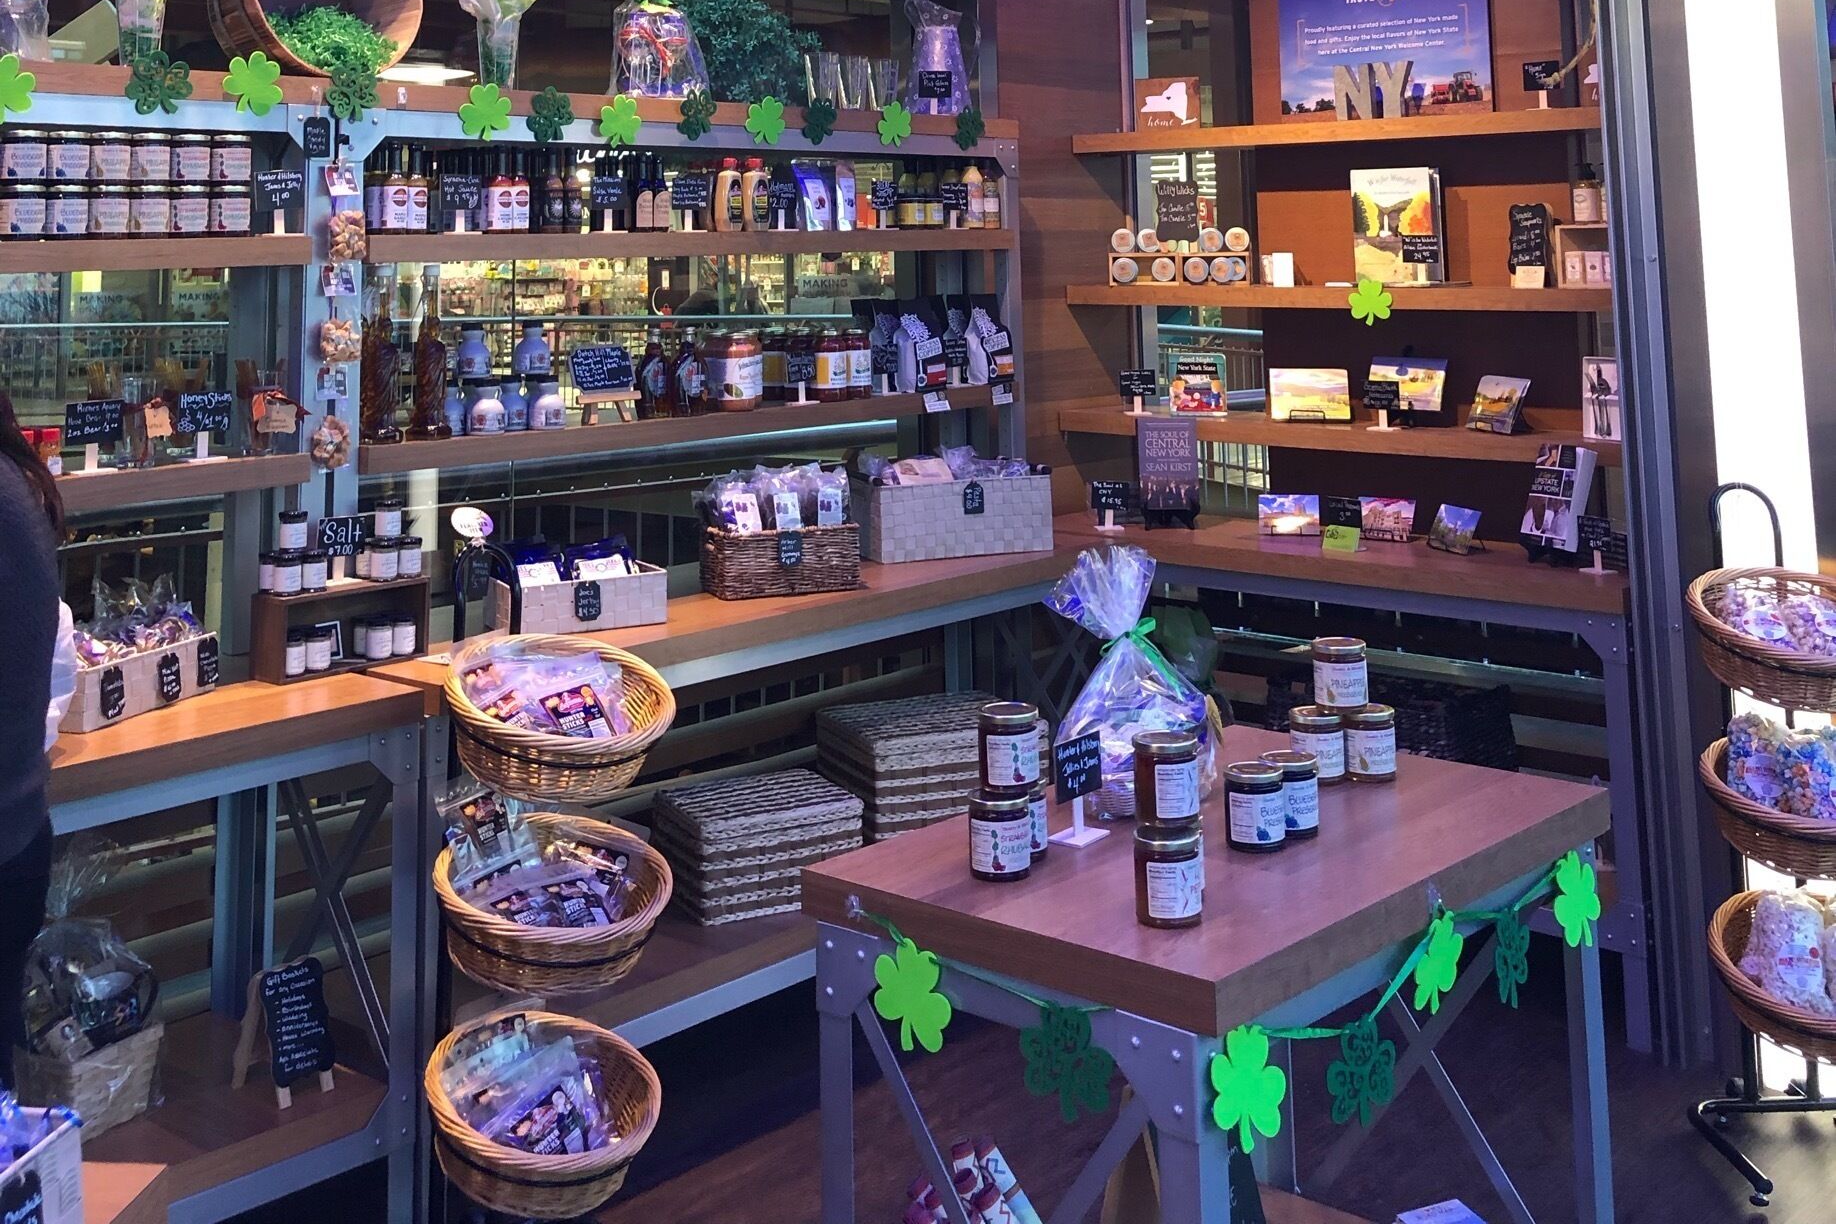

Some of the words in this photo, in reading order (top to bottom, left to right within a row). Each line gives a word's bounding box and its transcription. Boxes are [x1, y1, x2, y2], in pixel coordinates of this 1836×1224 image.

[1304, 26, 1326, 35] Proudly
[1327, 24, 1351, 33] featuring
[1380, 19, 1406, 27] selection
[1407, 17, 1413, 25] of
[1304, 38, 1317, 46] food
[1344, 34, 1360, 43] Enjoy
[1361, 33, 1371, 41] the
[1386, 30, 1406, 38] flavors
[1428, 27, 1441, 35] York
[1442, 25, 1459, 33] State
[1349, 45, 1370, 54] Central
[1384, 43, 1397, 51] York
[1398, 41, 1424, 49] Welcome
[1333, 60, 1414, 122] NY
[1147, 116, 1174, 127] home
[803, 279, 848, 288] MAKING
[79, 295, 123, 304] MAKING
[179, 293, 220, 302] MAKING
[180, 392, 208, 408] Honey
[1145, 431, 1159, 439] THE
[1160, 431, 1179, 439] SOUL
[1145, 438, 1191, 449] CENTRAL
[1145, 449, 1167, 457] NEW
[1168, 448, 1192, 457] YORK
[1145, 463, 1168, 472] SEAN
[1170, 462, 1192, 471] KIRST
[1534, 478, 1559, 486] UPSTATE
[323, 518, 363, 544] Salt
[328, 544, 353, 556] $7.00
[558, 712, 586, 725] HUNTER
[562, 718, 585, 730] STICKS
